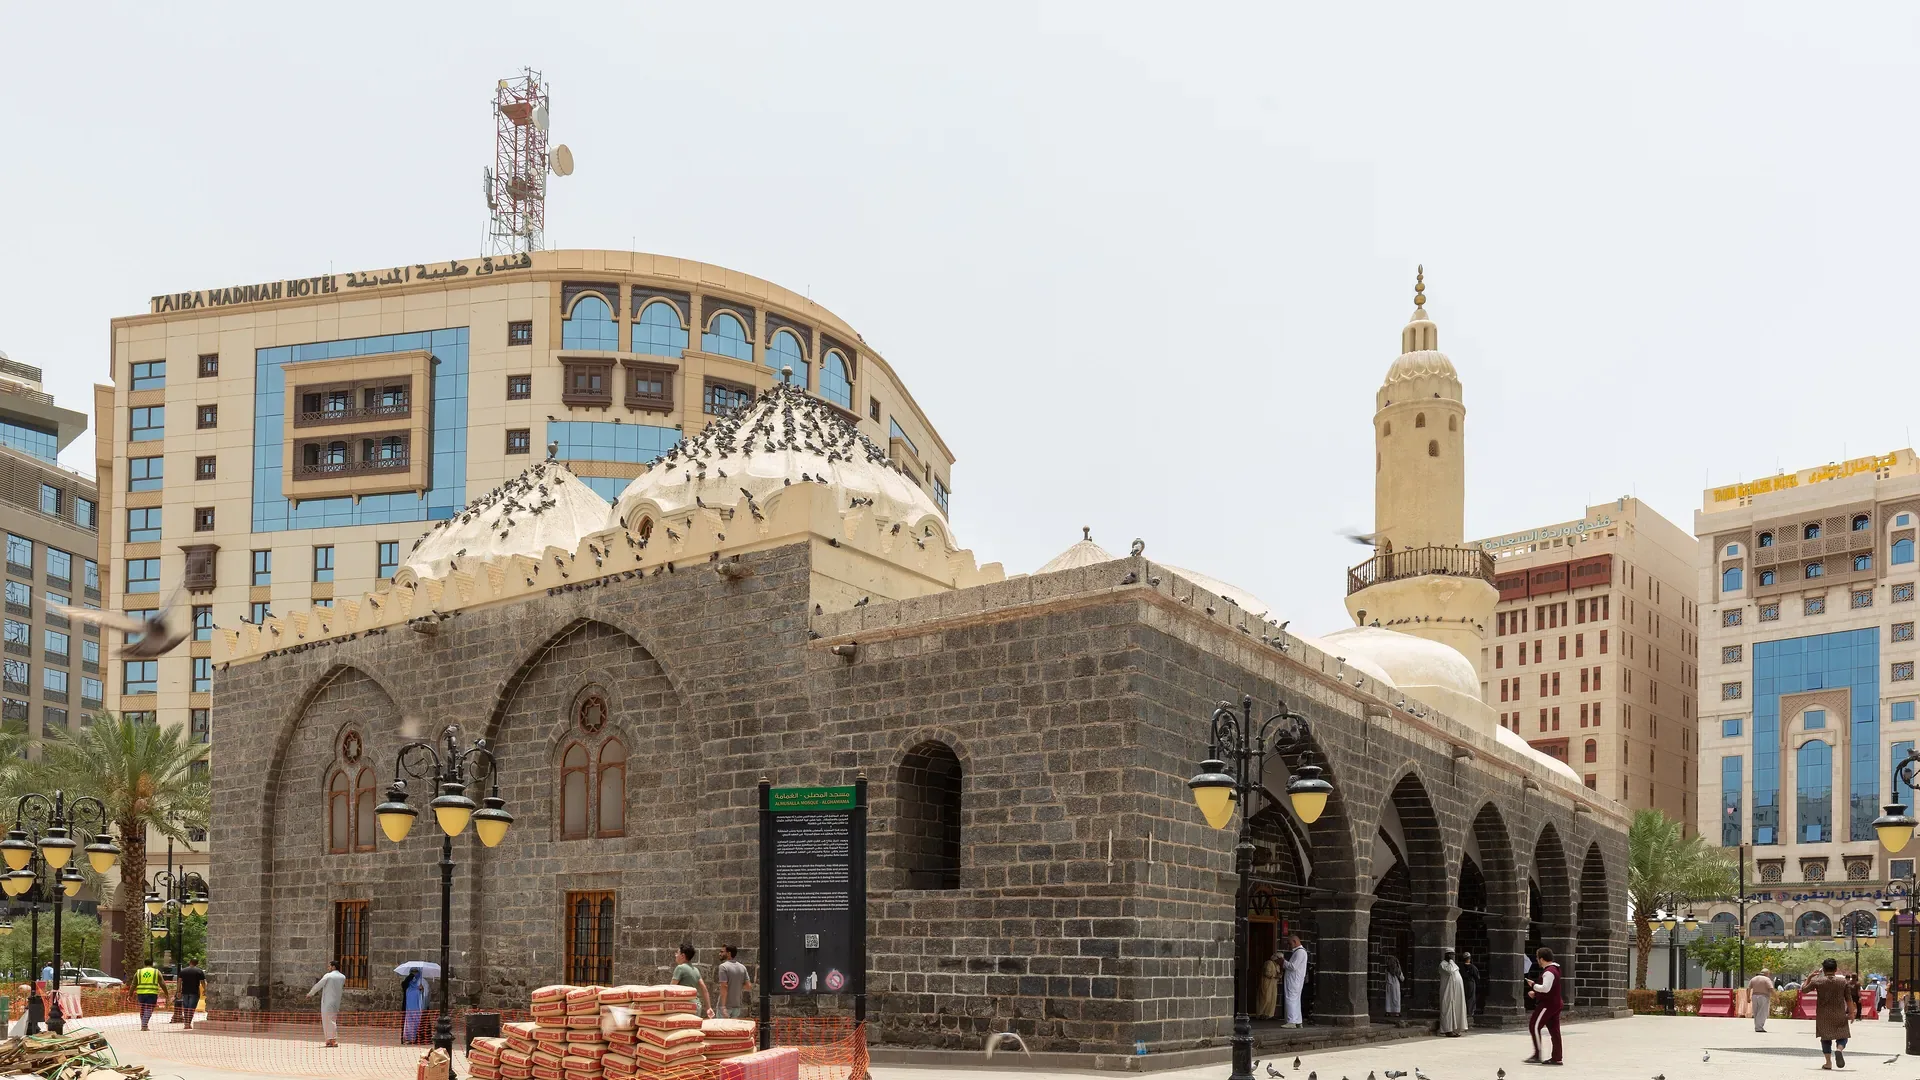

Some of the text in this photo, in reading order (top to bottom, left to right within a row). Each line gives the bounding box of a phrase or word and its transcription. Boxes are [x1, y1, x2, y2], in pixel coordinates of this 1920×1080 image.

[346, 252, 532, 288] فندق طيبة المدينة
[151, 275, 338, 314] TAIBA MADINAH HOTEL
[1773, 473, 1798, 490] HOTEL
[1484, 514, 1611, 550] فندق وردة السعادة
[1792, 890, 1835, 902] التقوى
[1836, 889, 1873, 900] منازل
